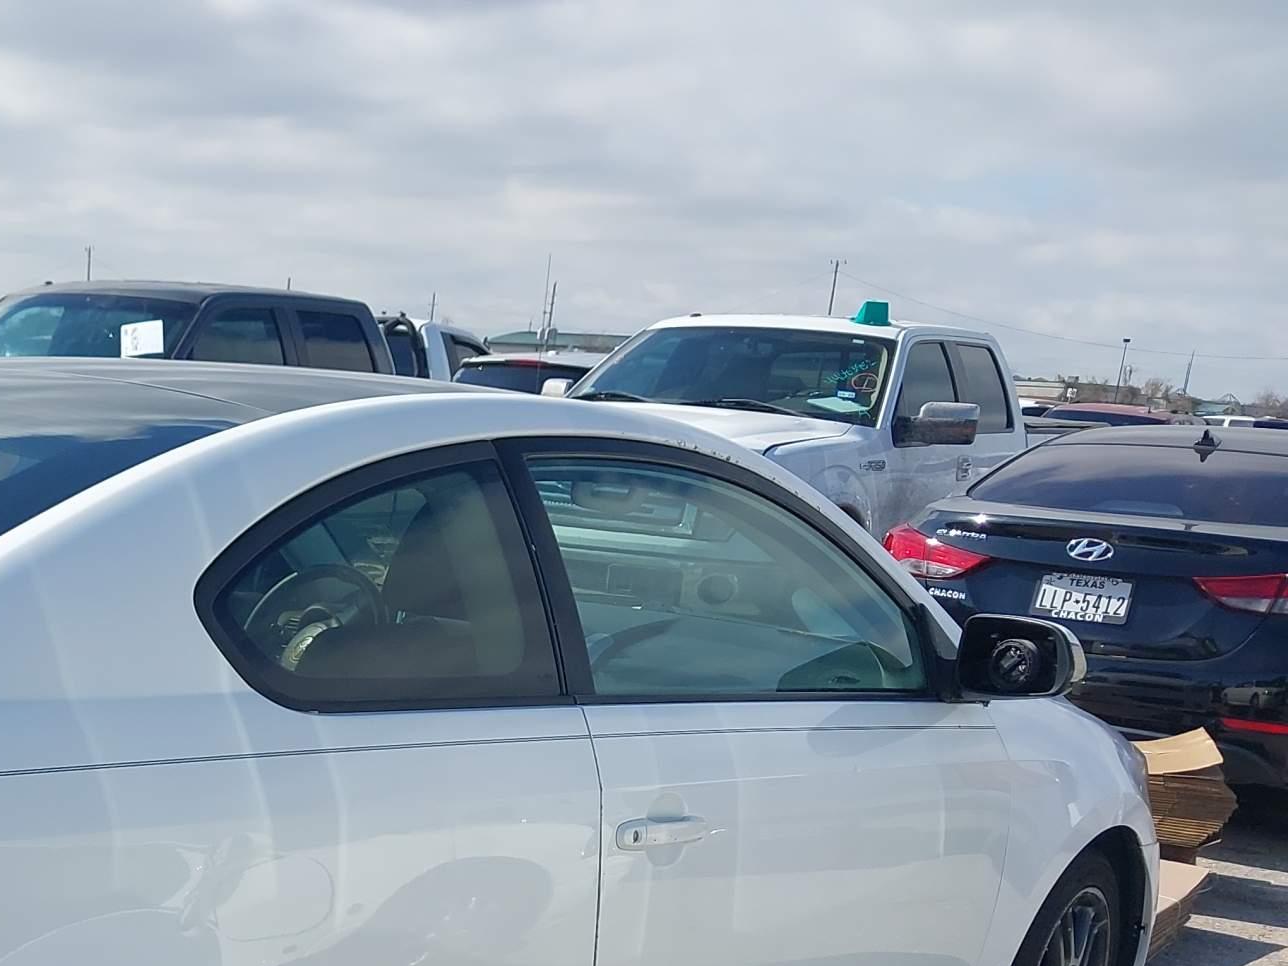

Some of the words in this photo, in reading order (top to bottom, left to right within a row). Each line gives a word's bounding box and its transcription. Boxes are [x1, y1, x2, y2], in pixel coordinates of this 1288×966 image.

[1069, 578, 1106, 589] TEXAS
[928, 587, 966, 600] CHACON
[1051, 609, 1104, 622] CHACON
